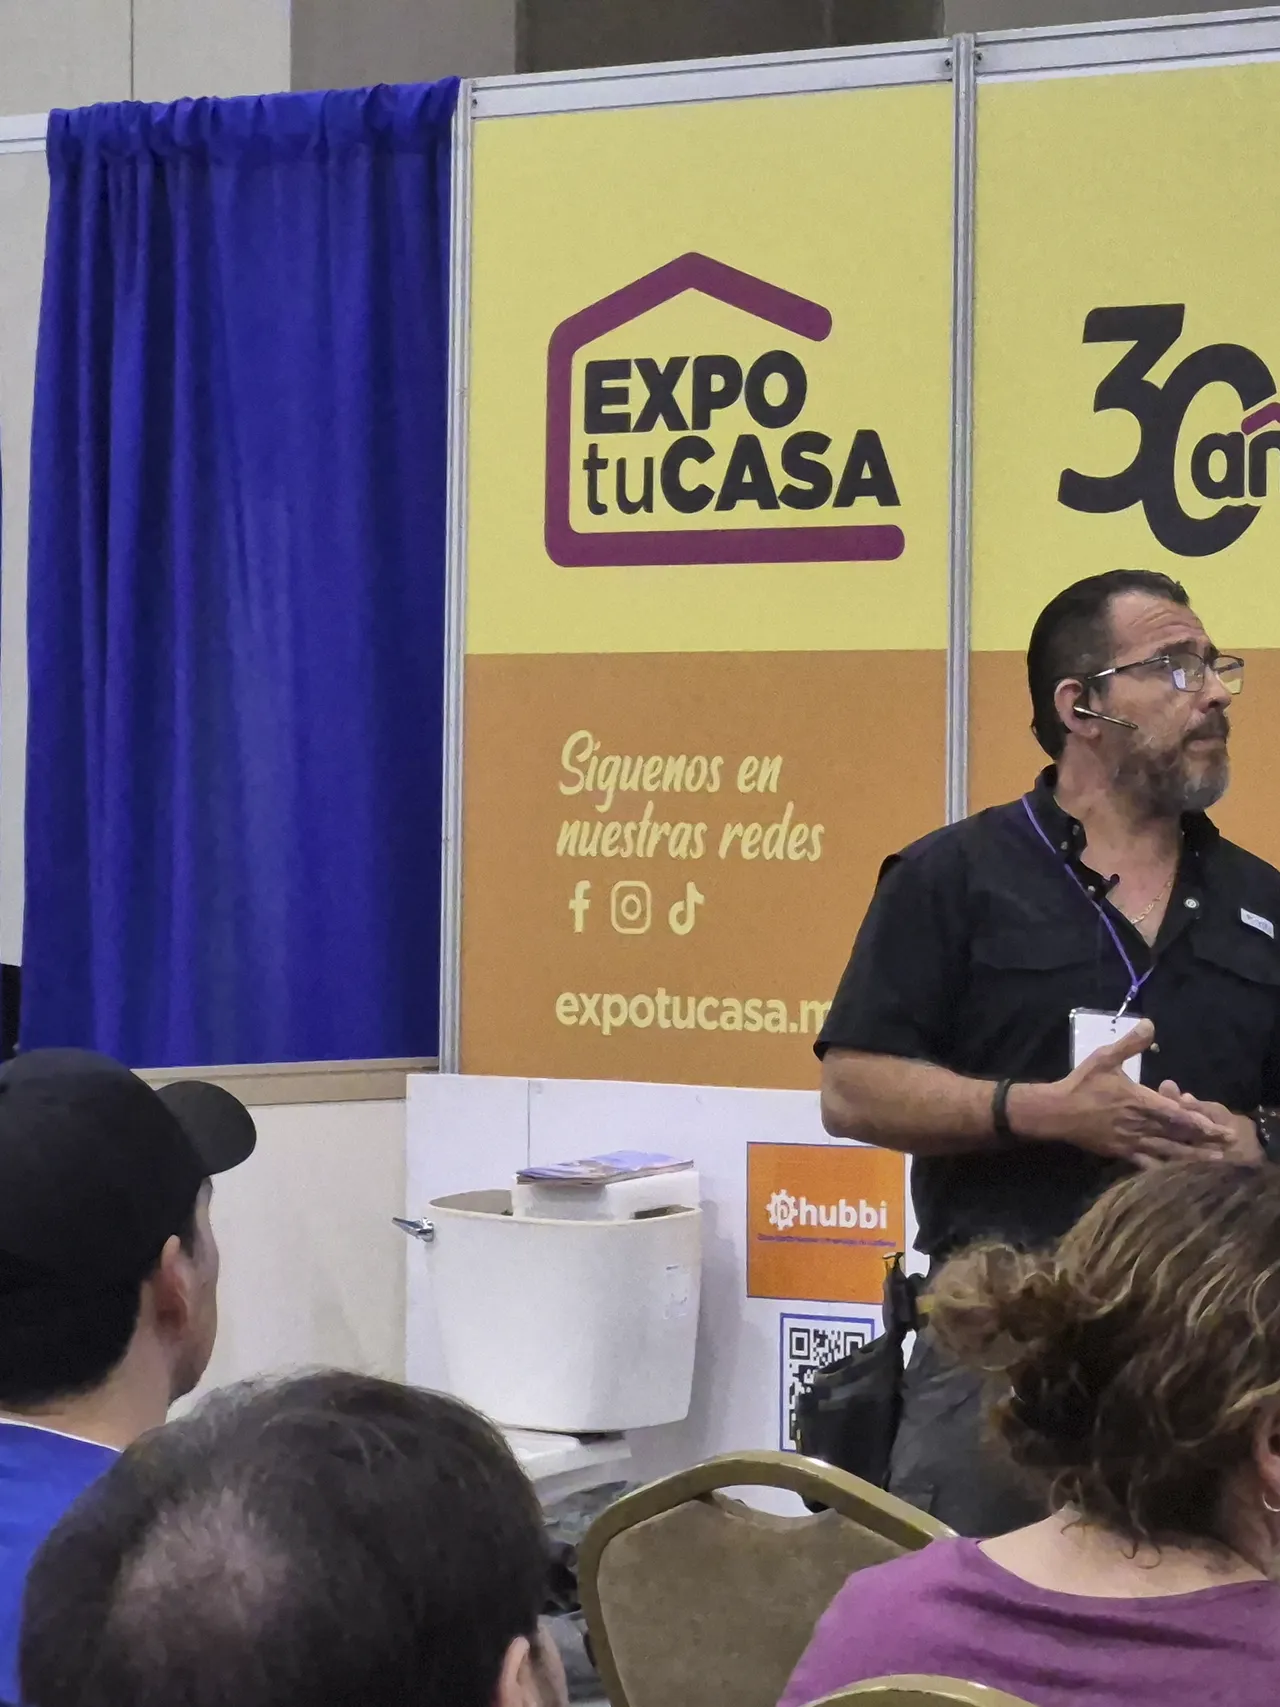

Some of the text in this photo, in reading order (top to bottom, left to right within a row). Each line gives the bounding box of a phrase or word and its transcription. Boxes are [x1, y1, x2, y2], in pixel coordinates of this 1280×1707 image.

[583, 349, 808, 435] EXPO
[1056, 303, 1278, 558] 30
[582, 429, 901, 515] tuCASA
[736, 754, 783, 794] en
[556, 800, 826, 863] nuestras redes
[798, 1196, 888, 1229] hubbi
